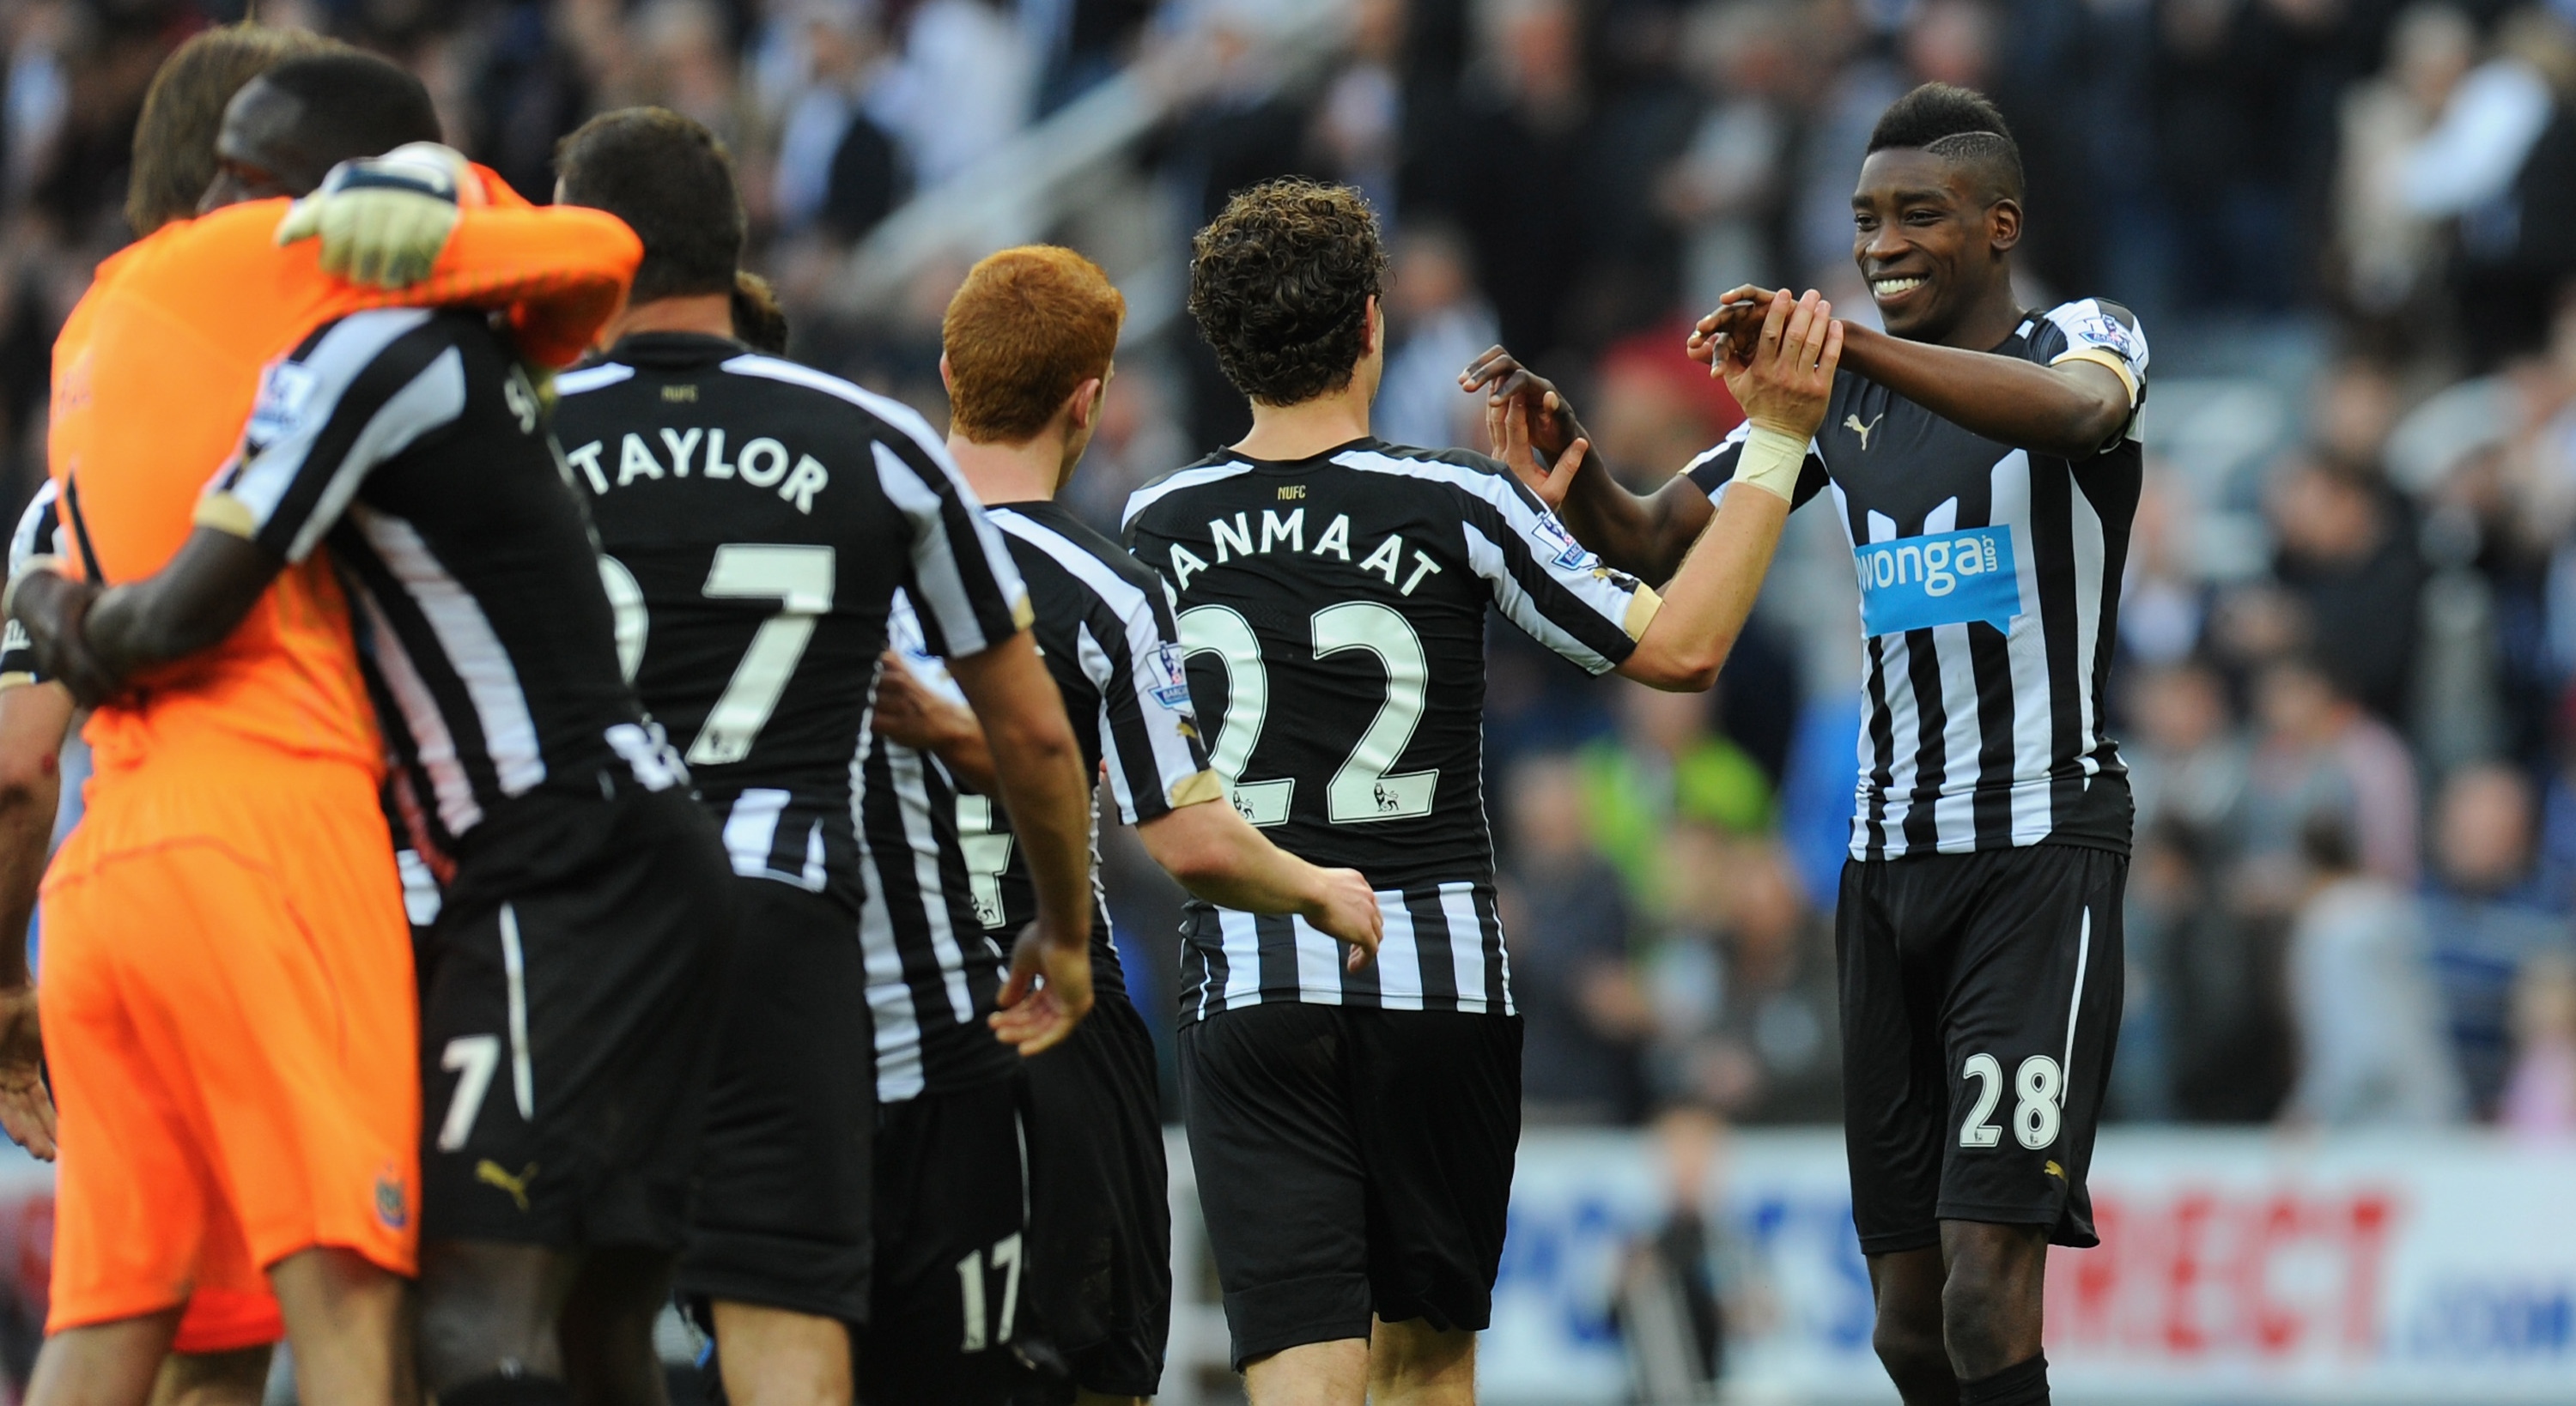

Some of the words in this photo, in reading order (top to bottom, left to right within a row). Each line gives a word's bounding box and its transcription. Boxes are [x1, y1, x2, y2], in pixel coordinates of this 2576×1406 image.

[567, 427, 829, 514] TAYLOR
[1278, 485, 1306, 500] NUFC
[1162, 508, 1442, 607] ANMAAT
[1856, 536, 1985, 597] wonga
[1982, 534, 1998, 573] .com
[1176, 601, 1440, 827] 22
[436, 1033, 501, 1154] 7
[1959, 1052, 2062, 1150] 28
[956, 1230, 1023, 1353] 17
